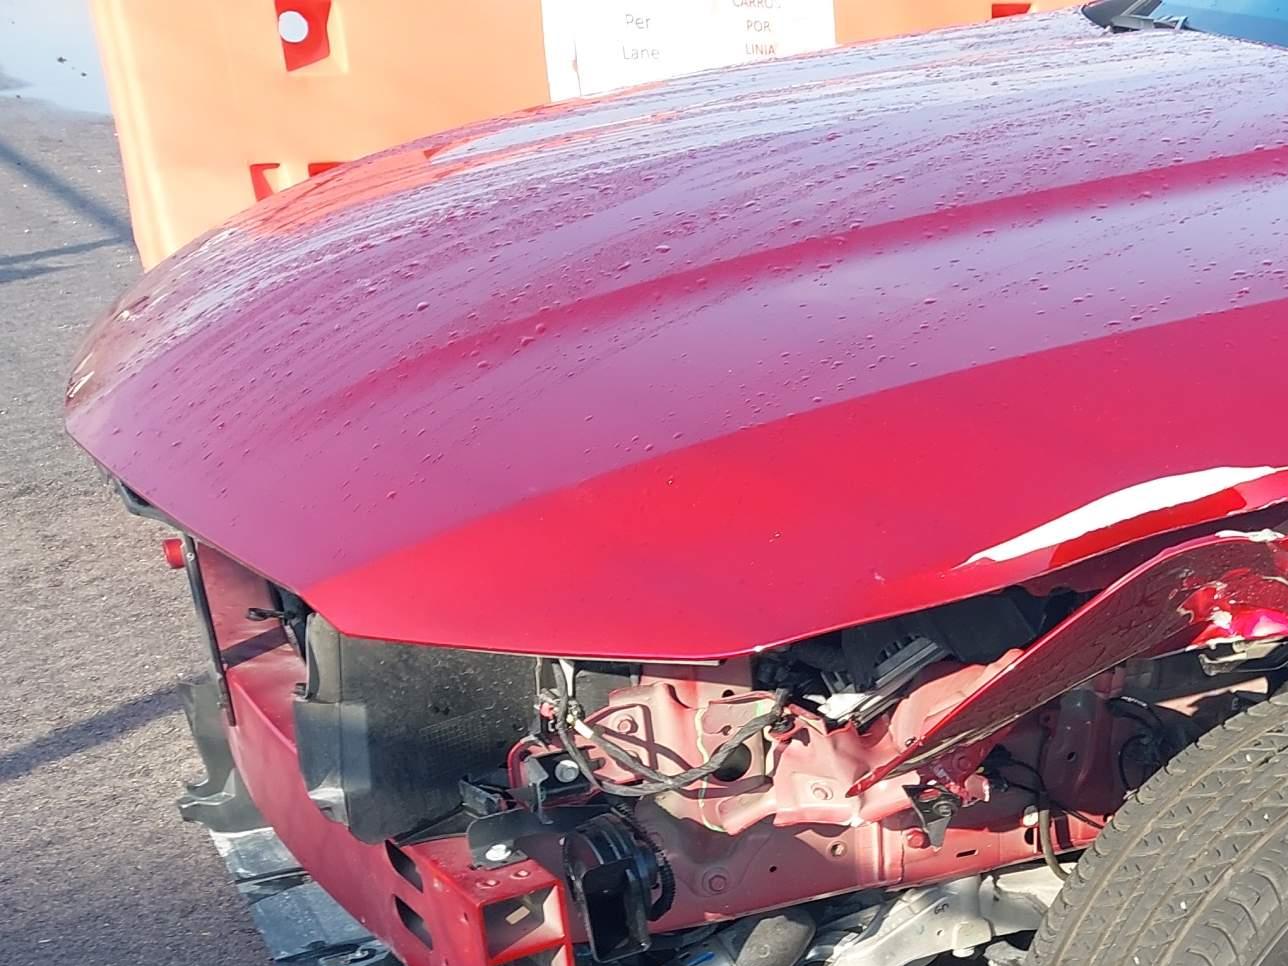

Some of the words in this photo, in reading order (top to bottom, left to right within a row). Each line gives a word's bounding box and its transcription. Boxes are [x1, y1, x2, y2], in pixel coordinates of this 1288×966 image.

[625, 14, 651, 30] Per
[746, 19, 772, 33] POR
[622, 45, 660, 60] Lane
[745, 43, 776, 55] LINIA
